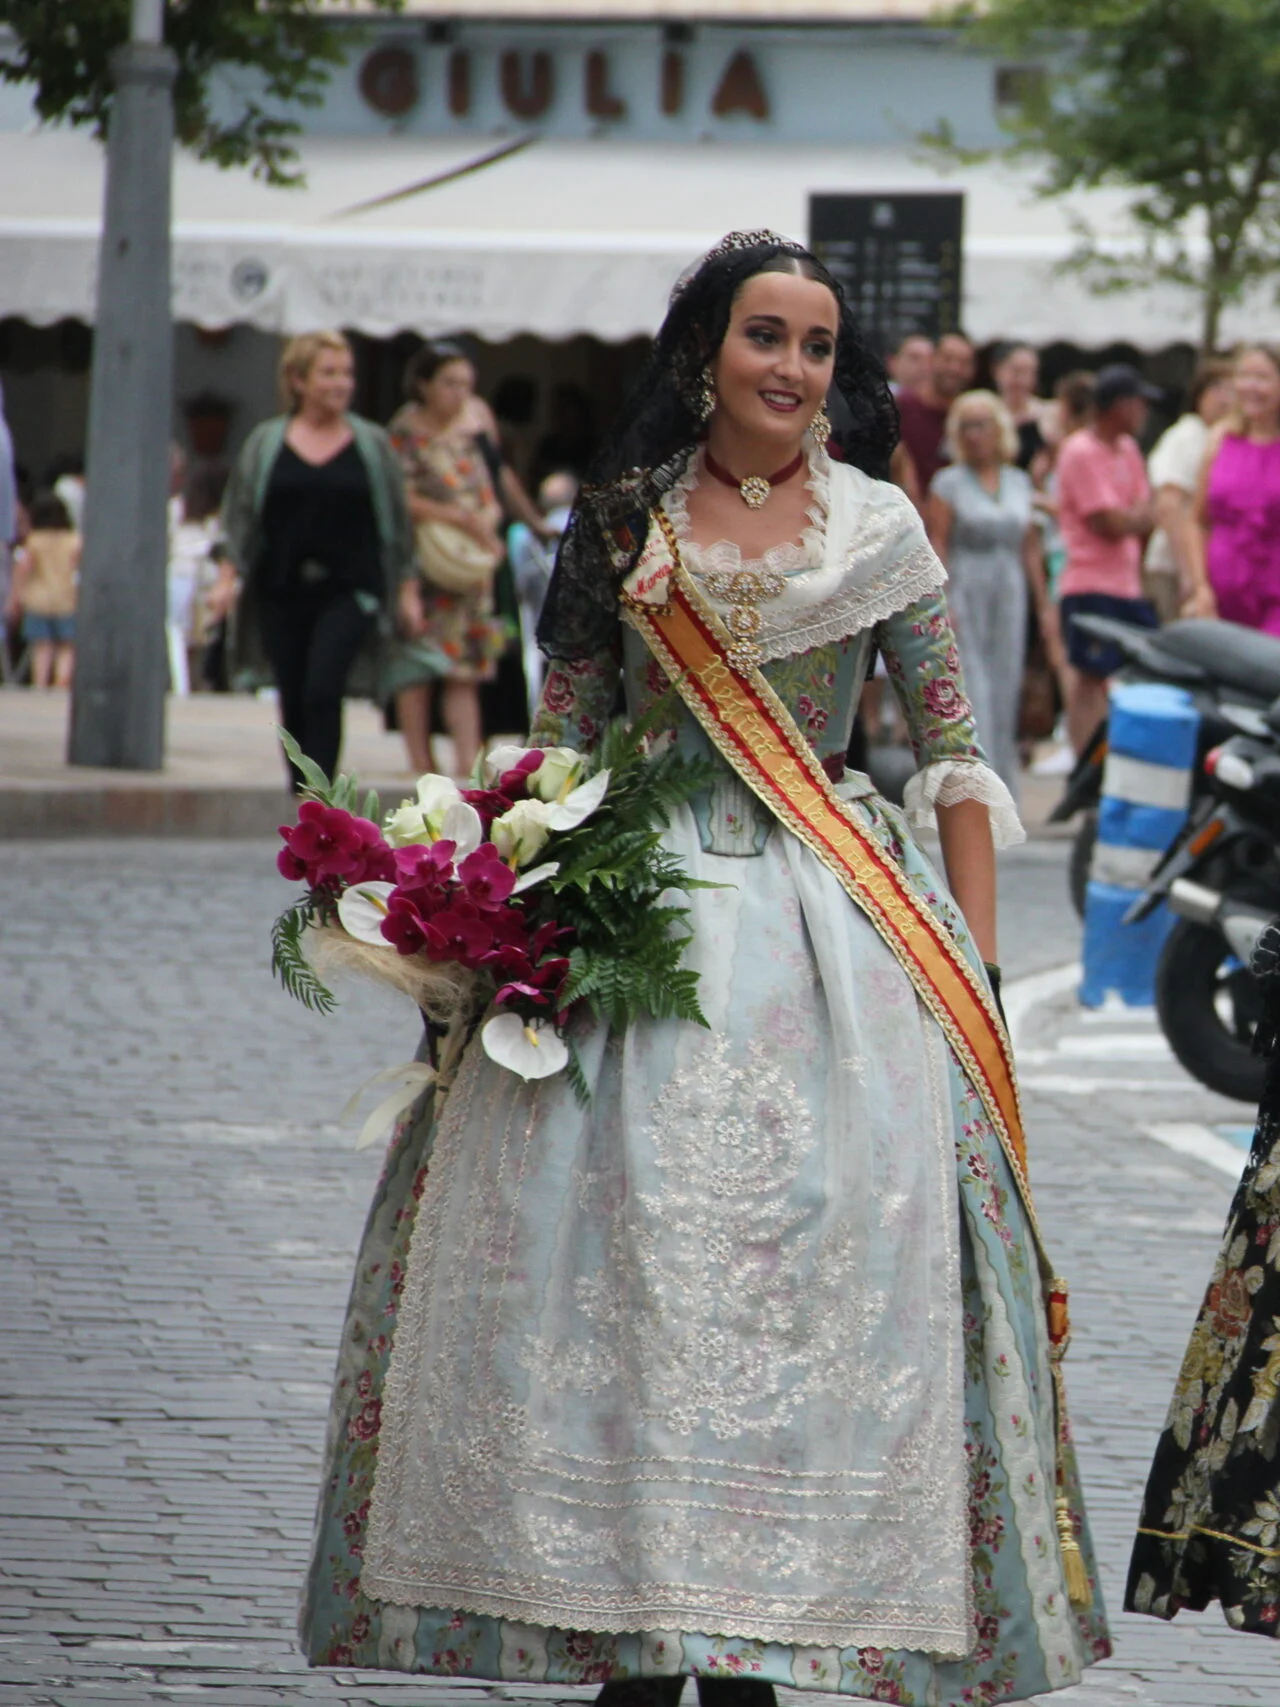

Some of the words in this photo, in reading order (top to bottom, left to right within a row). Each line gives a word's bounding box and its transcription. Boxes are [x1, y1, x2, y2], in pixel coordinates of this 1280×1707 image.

[359, 47, 770, 121] GIULIA
[694, 654, 777, 759] Regina
[773, 761, 802, 797] de
[802, 796, 825, 823] la
